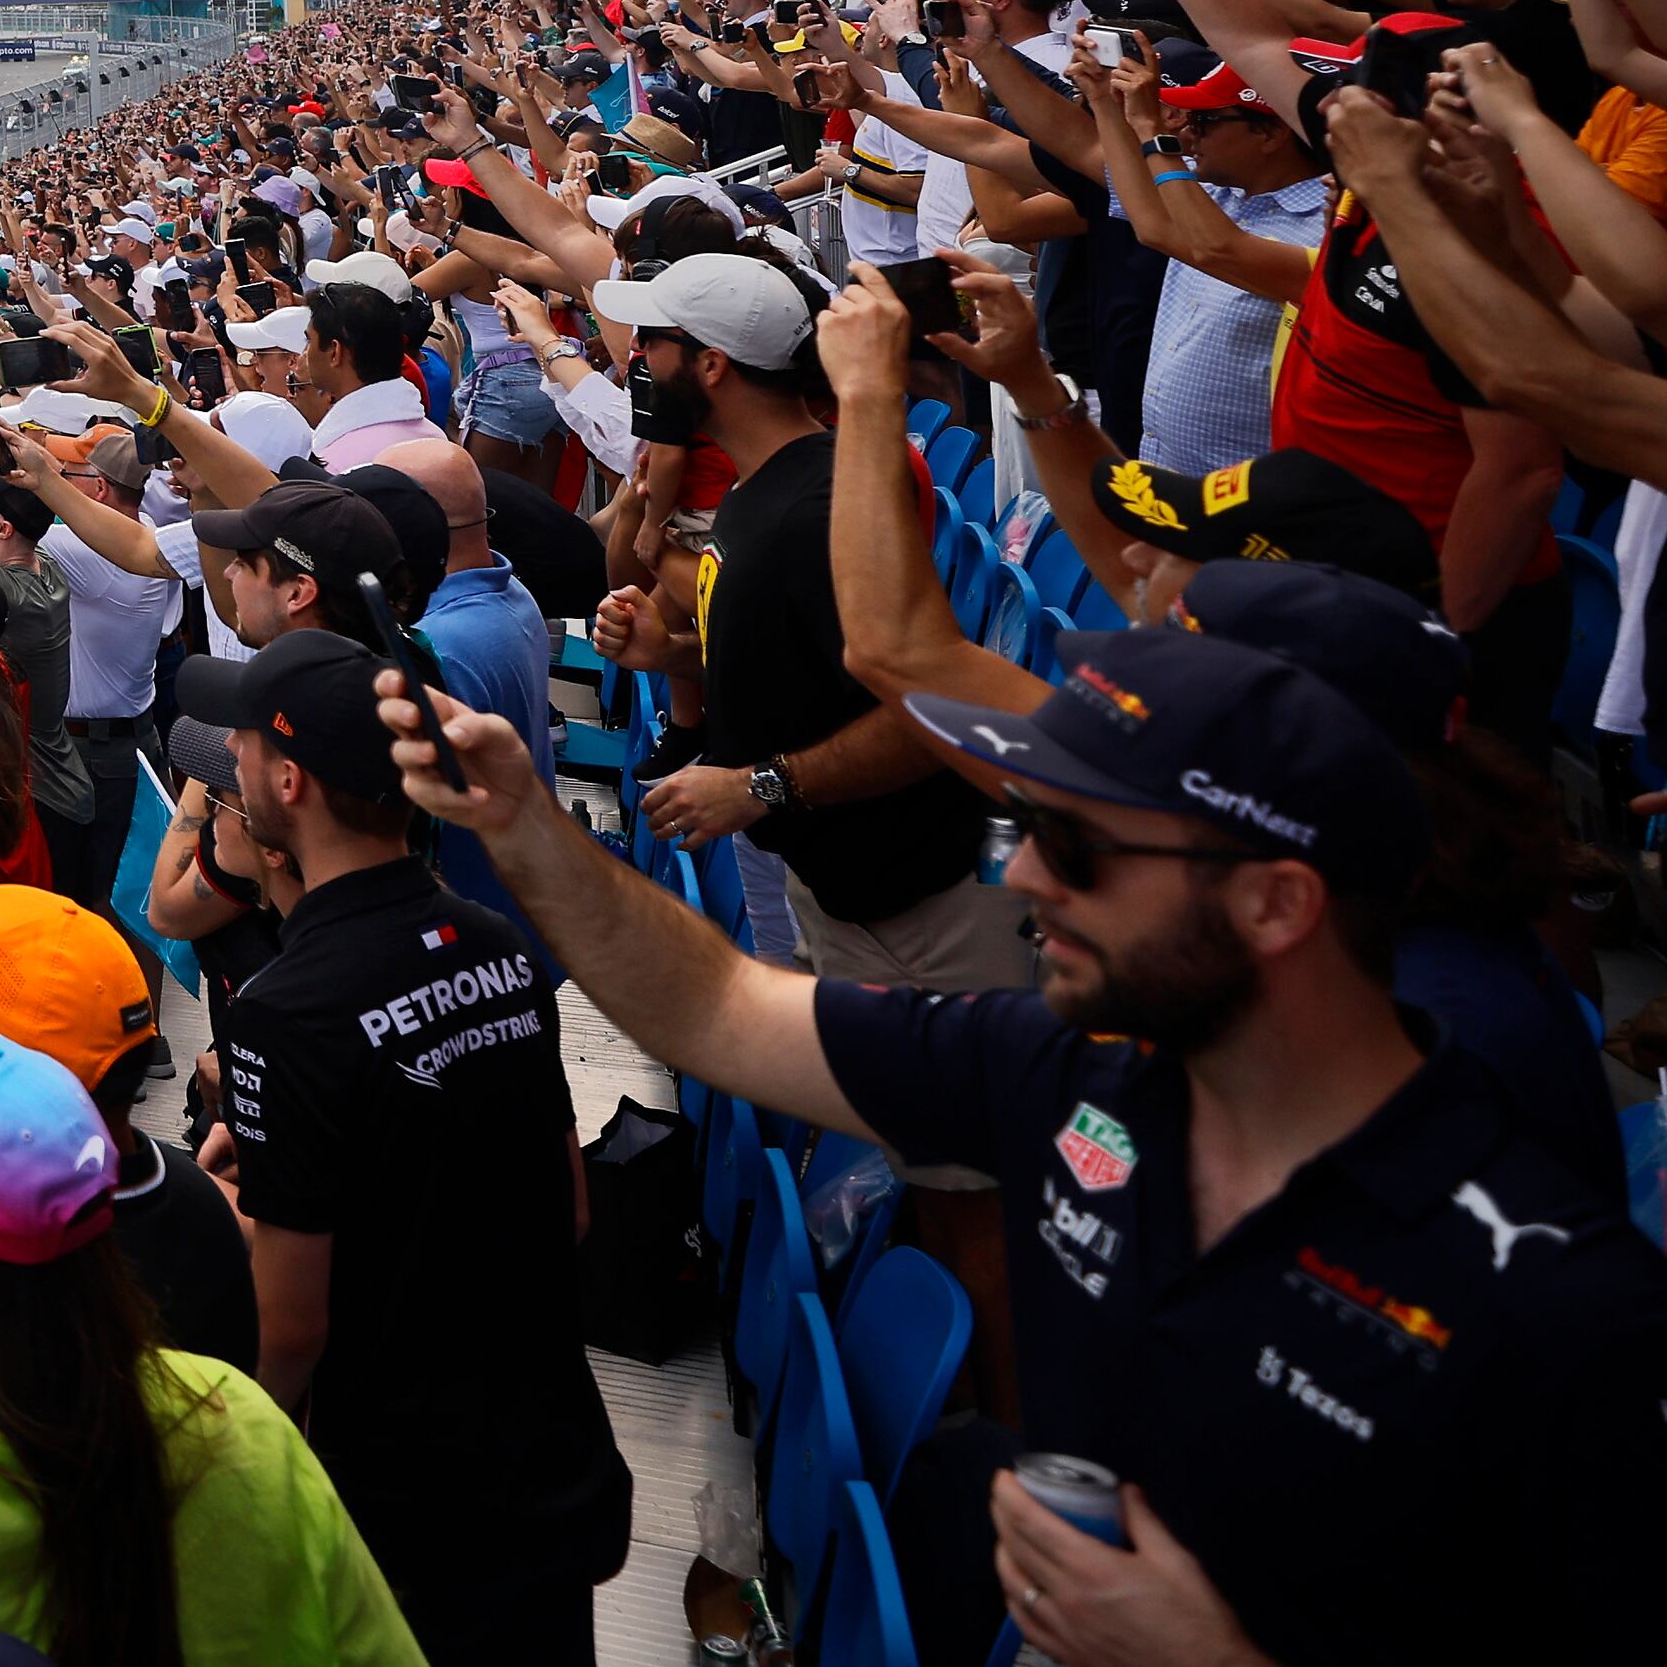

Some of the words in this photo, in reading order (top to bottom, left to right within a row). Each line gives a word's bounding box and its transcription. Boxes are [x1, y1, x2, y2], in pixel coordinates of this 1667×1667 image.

[1179, 768, 1318, 849] CarNext
[358, 953, 534, 1048] PETRONAS
[415, 1009, 542, 1079] CROWDSTRIKE
[1286, 1366, 1374, 1440] Tezos
